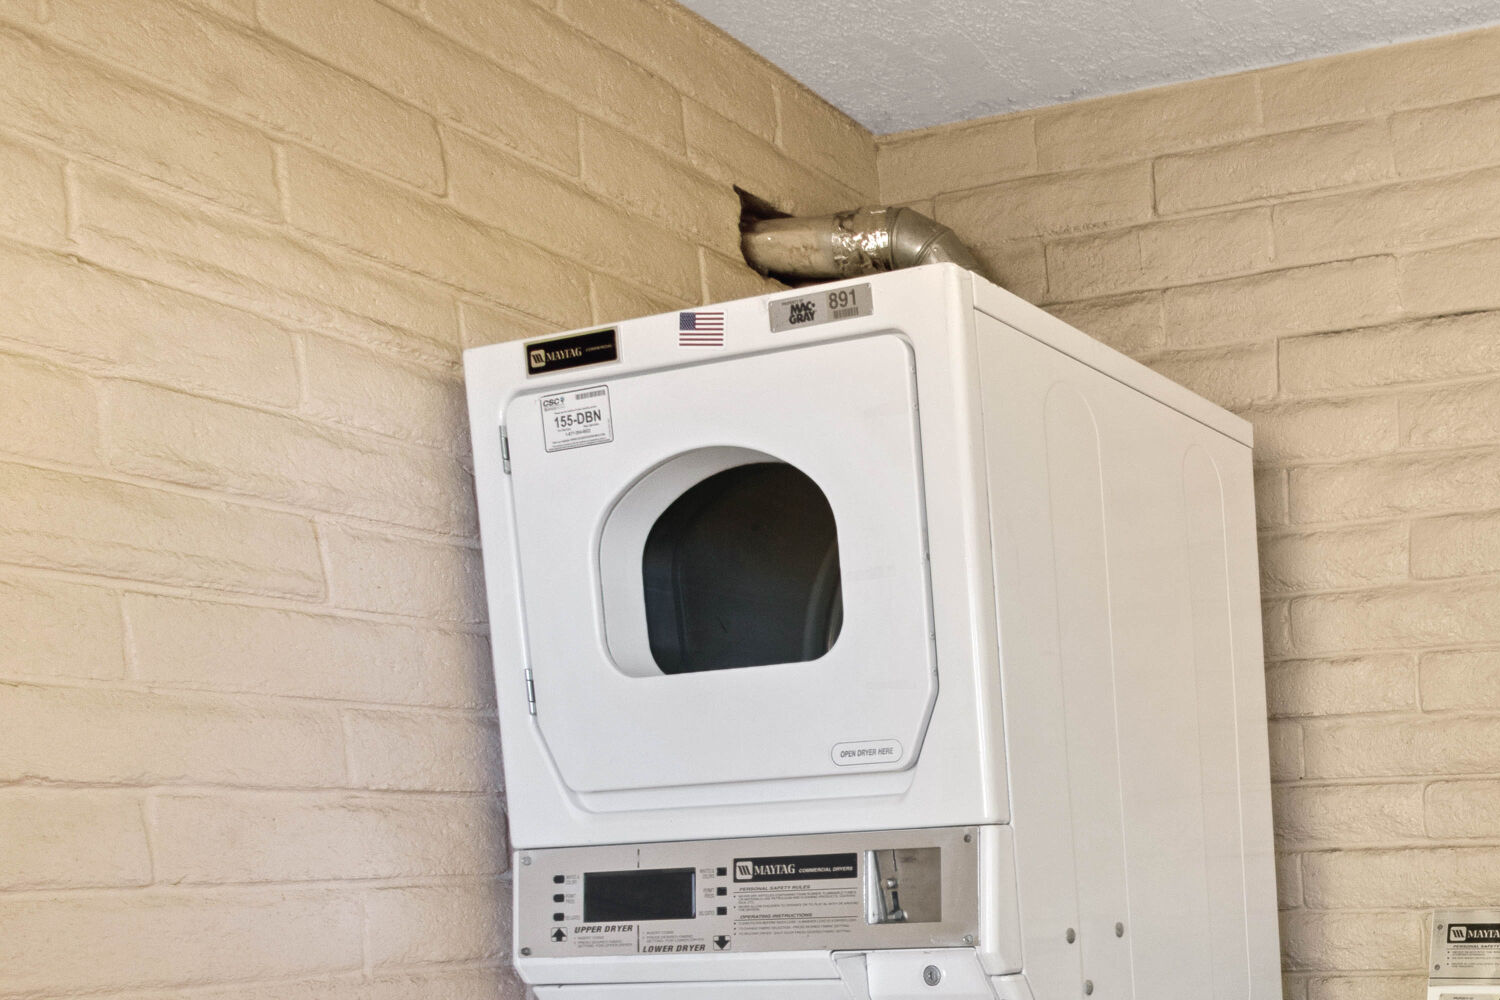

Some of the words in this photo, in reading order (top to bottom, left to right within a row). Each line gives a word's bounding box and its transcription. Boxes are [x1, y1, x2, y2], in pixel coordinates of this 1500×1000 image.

[829, 289, 856, 309] 891
[789, 311, 815, 324] GRAY
[547, 348, 582, 361] MAYTAG
[543, 398, 560, 407] CSC
[554, 409, 602, 428] 155-DBN
[840, 750, 856, 758] OPEN
[857, 748, 876, 756] DRYER
[878, 747, 894, 755] HERE
[754, 864, 795, 875] MAYTAG
[574, 926, 602, 934] UPPER
[604, 925, 633, 933] DRYER
[676, 944, 706, 952] DRYER
